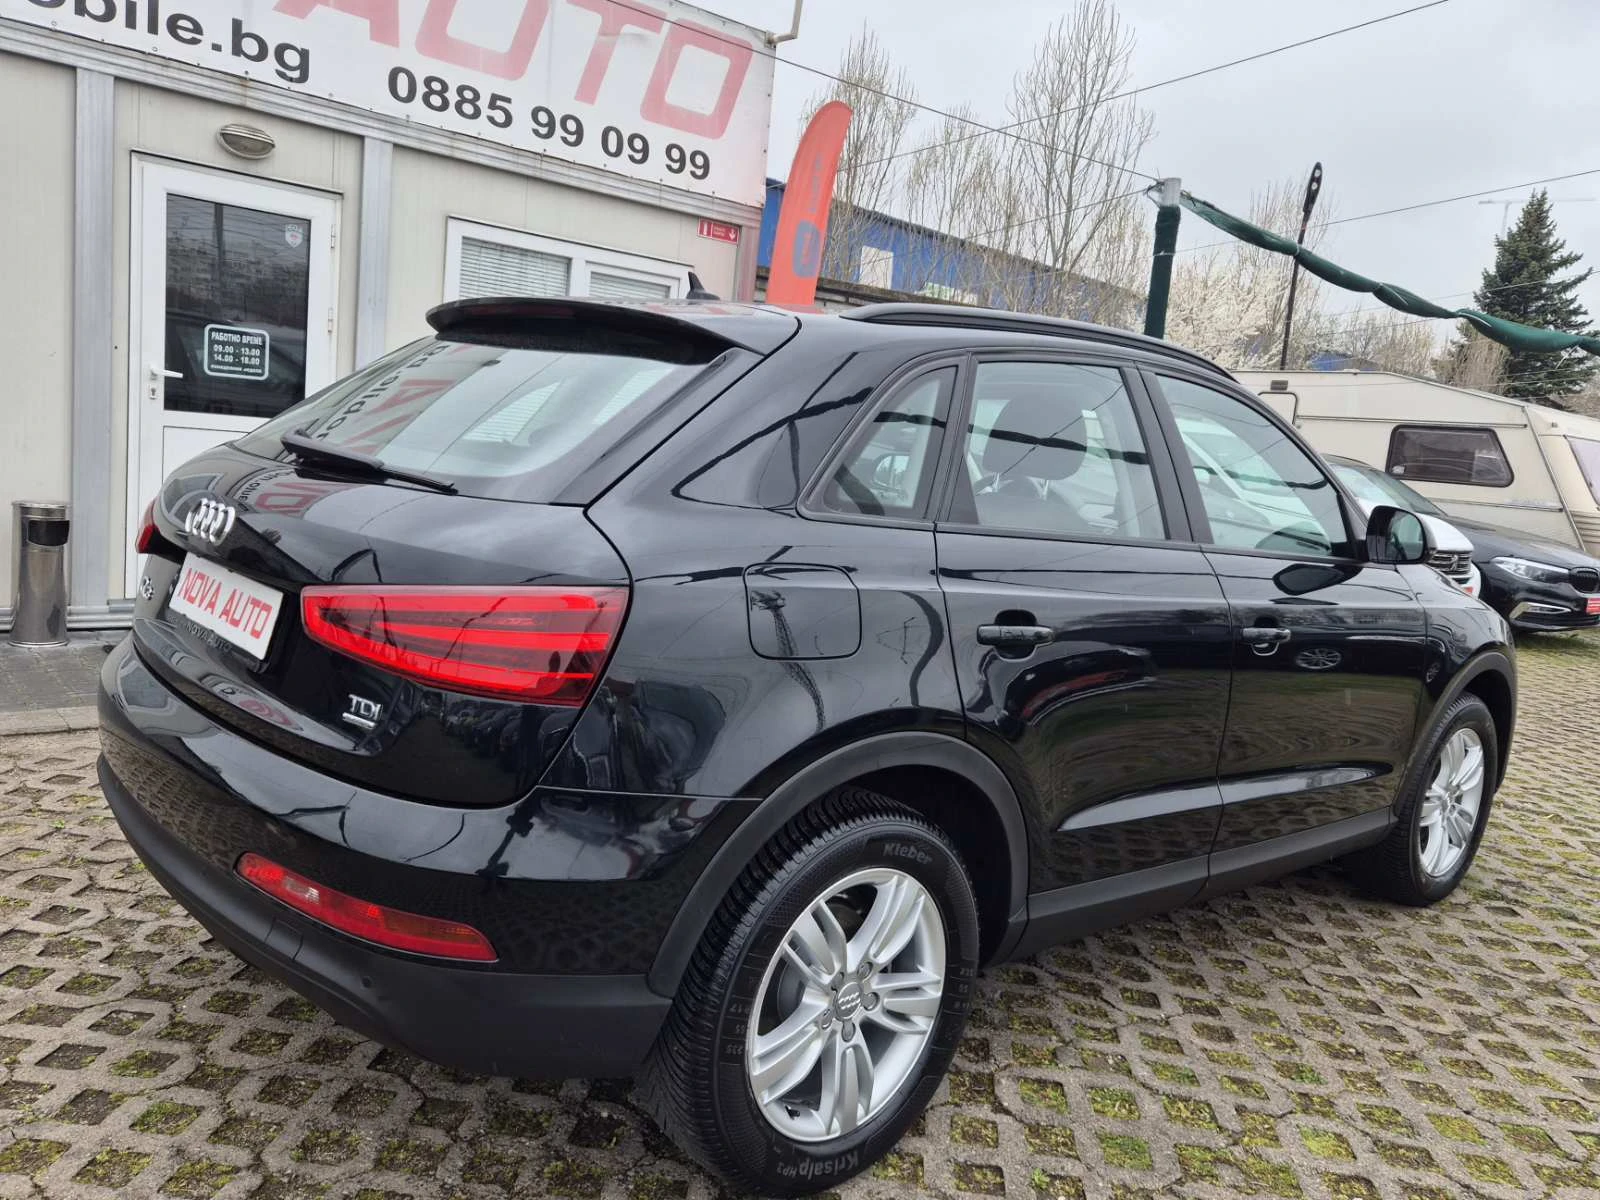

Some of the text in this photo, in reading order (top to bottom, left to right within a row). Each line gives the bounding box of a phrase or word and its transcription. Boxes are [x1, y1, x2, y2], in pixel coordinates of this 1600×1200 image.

[28, 0, 310, 83] bile.bg
[388, 66, 711, 180] 0885 99 09 99
[177, 567, 273, 640] NOVA AUTO
[348, 694, 382, 720] TDI
[882, 842, 934, 865] Kleber
[799, 1150, 859, 1180] Krisalp
